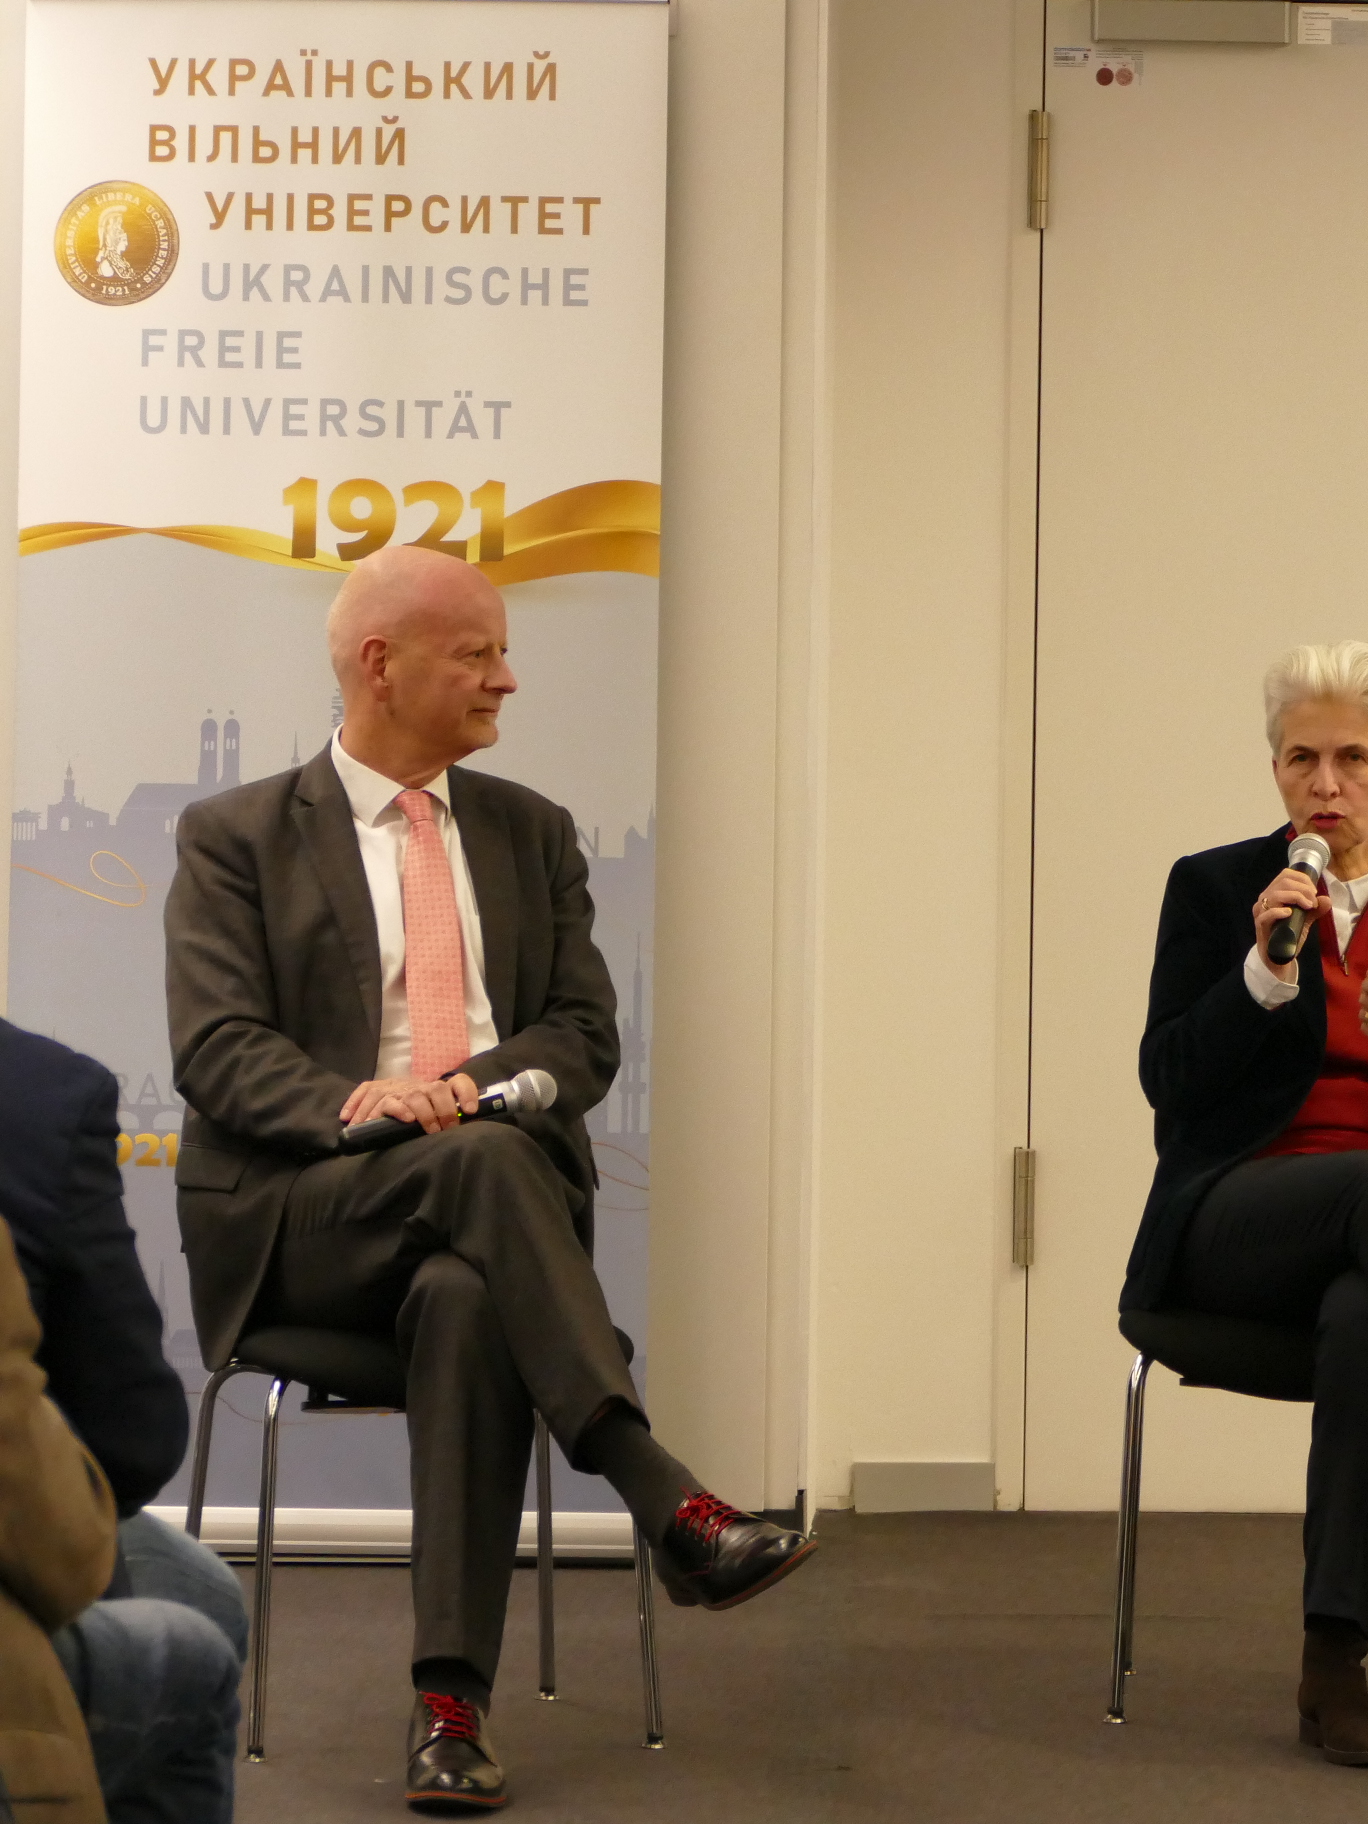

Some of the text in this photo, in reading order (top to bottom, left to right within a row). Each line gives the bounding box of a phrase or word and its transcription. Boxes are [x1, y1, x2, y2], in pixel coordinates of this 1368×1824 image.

[148, 48, 558, 102] УКРАЇНСЬКИЙ
[148, 114, 407, 167] ВІЛЬНИЙ
[65, 192, 169, 284] UNIVERSITAS LIBERA UCRAINENSIS
[205, 191, 602, 237] УНІВЕРСИТЕТ
[101, 285, 130, 295] 1921
[201, 262, 590, 308] UKRAINISCHE
[141, 328, 303, 370] FREIE
[139, 389, 513, 441] UNIVERSITÄT
[281, 475, 506, 562] 1921
[115, 1132, 178, 1168] 921
